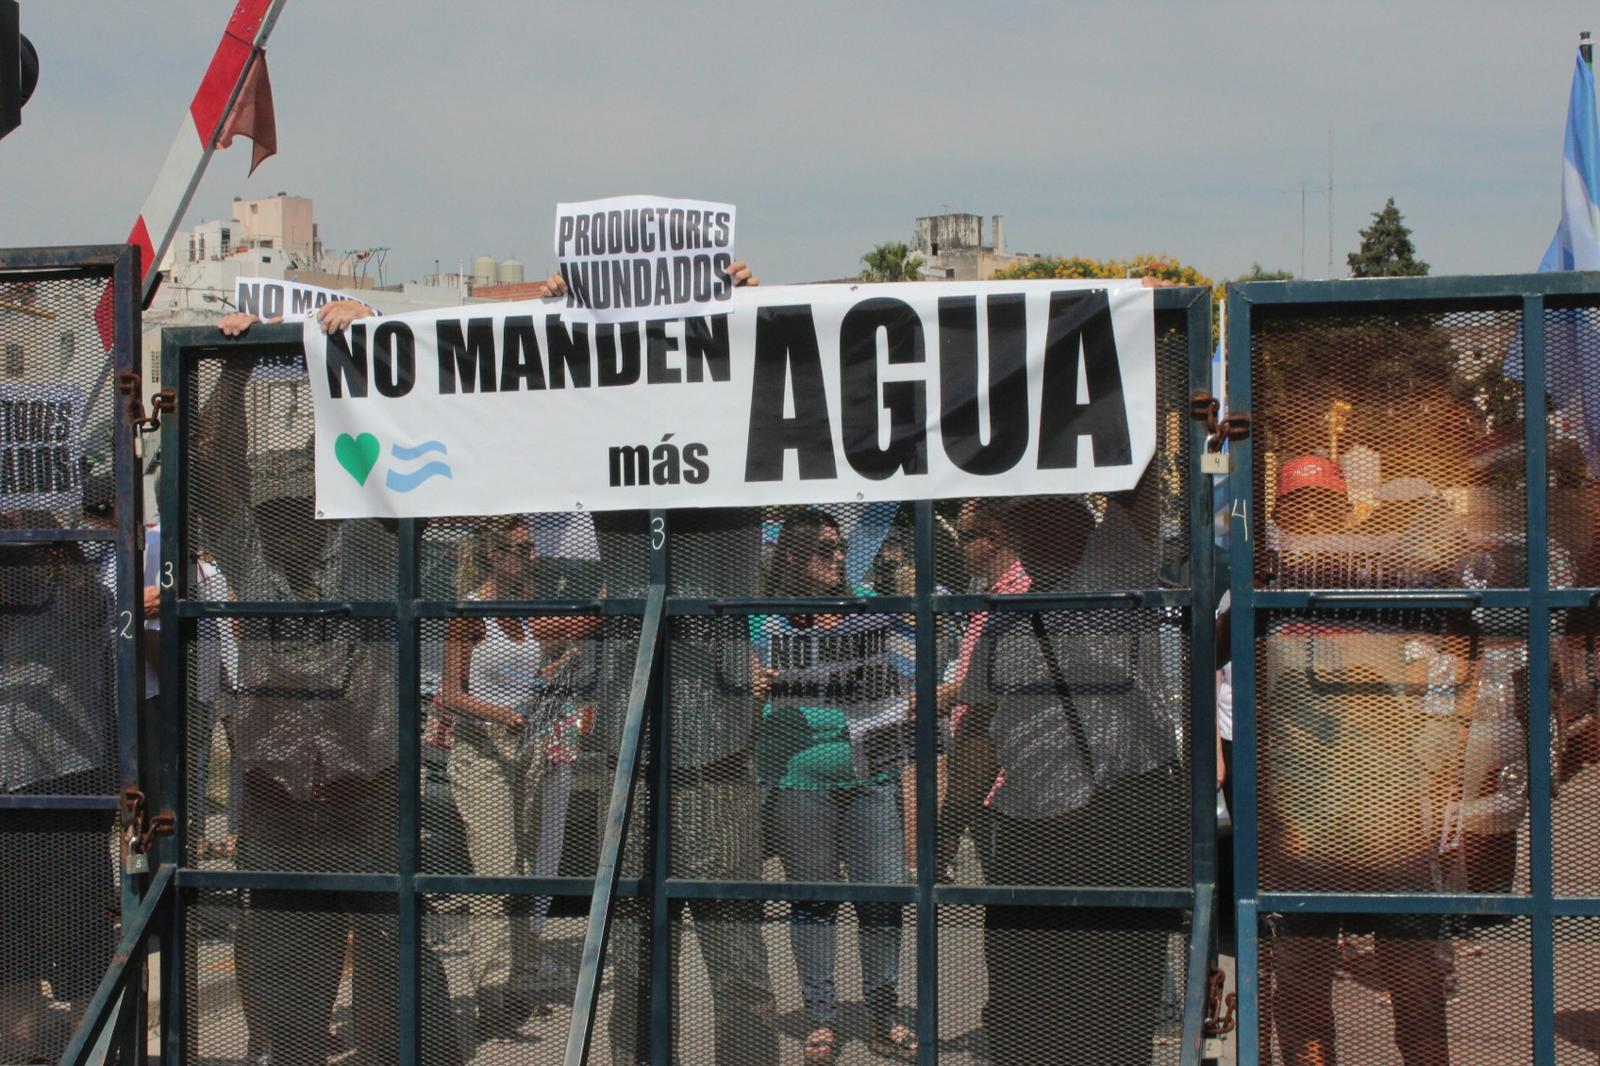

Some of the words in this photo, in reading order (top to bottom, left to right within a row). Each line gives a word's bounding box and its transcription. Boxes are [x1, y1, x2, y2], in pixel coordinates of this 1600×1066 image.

[558, 208, 730, 257] PRODUCTORES
[238, 283, 284, 319] NO
[560, 252, 732, 310] INUNDADOS
[326, 321, 416, 399] NO
[435, 311, 731, 394] MANDEN
[744, 289, 1132, 482] AGUA
[608, 433, 710, 488] más
[651, 517, 666, 551] 3
[1231, 498, 1249, 542] 4
[161, 561, 174, 589] 3
[120, 610, 133, 640] 2
